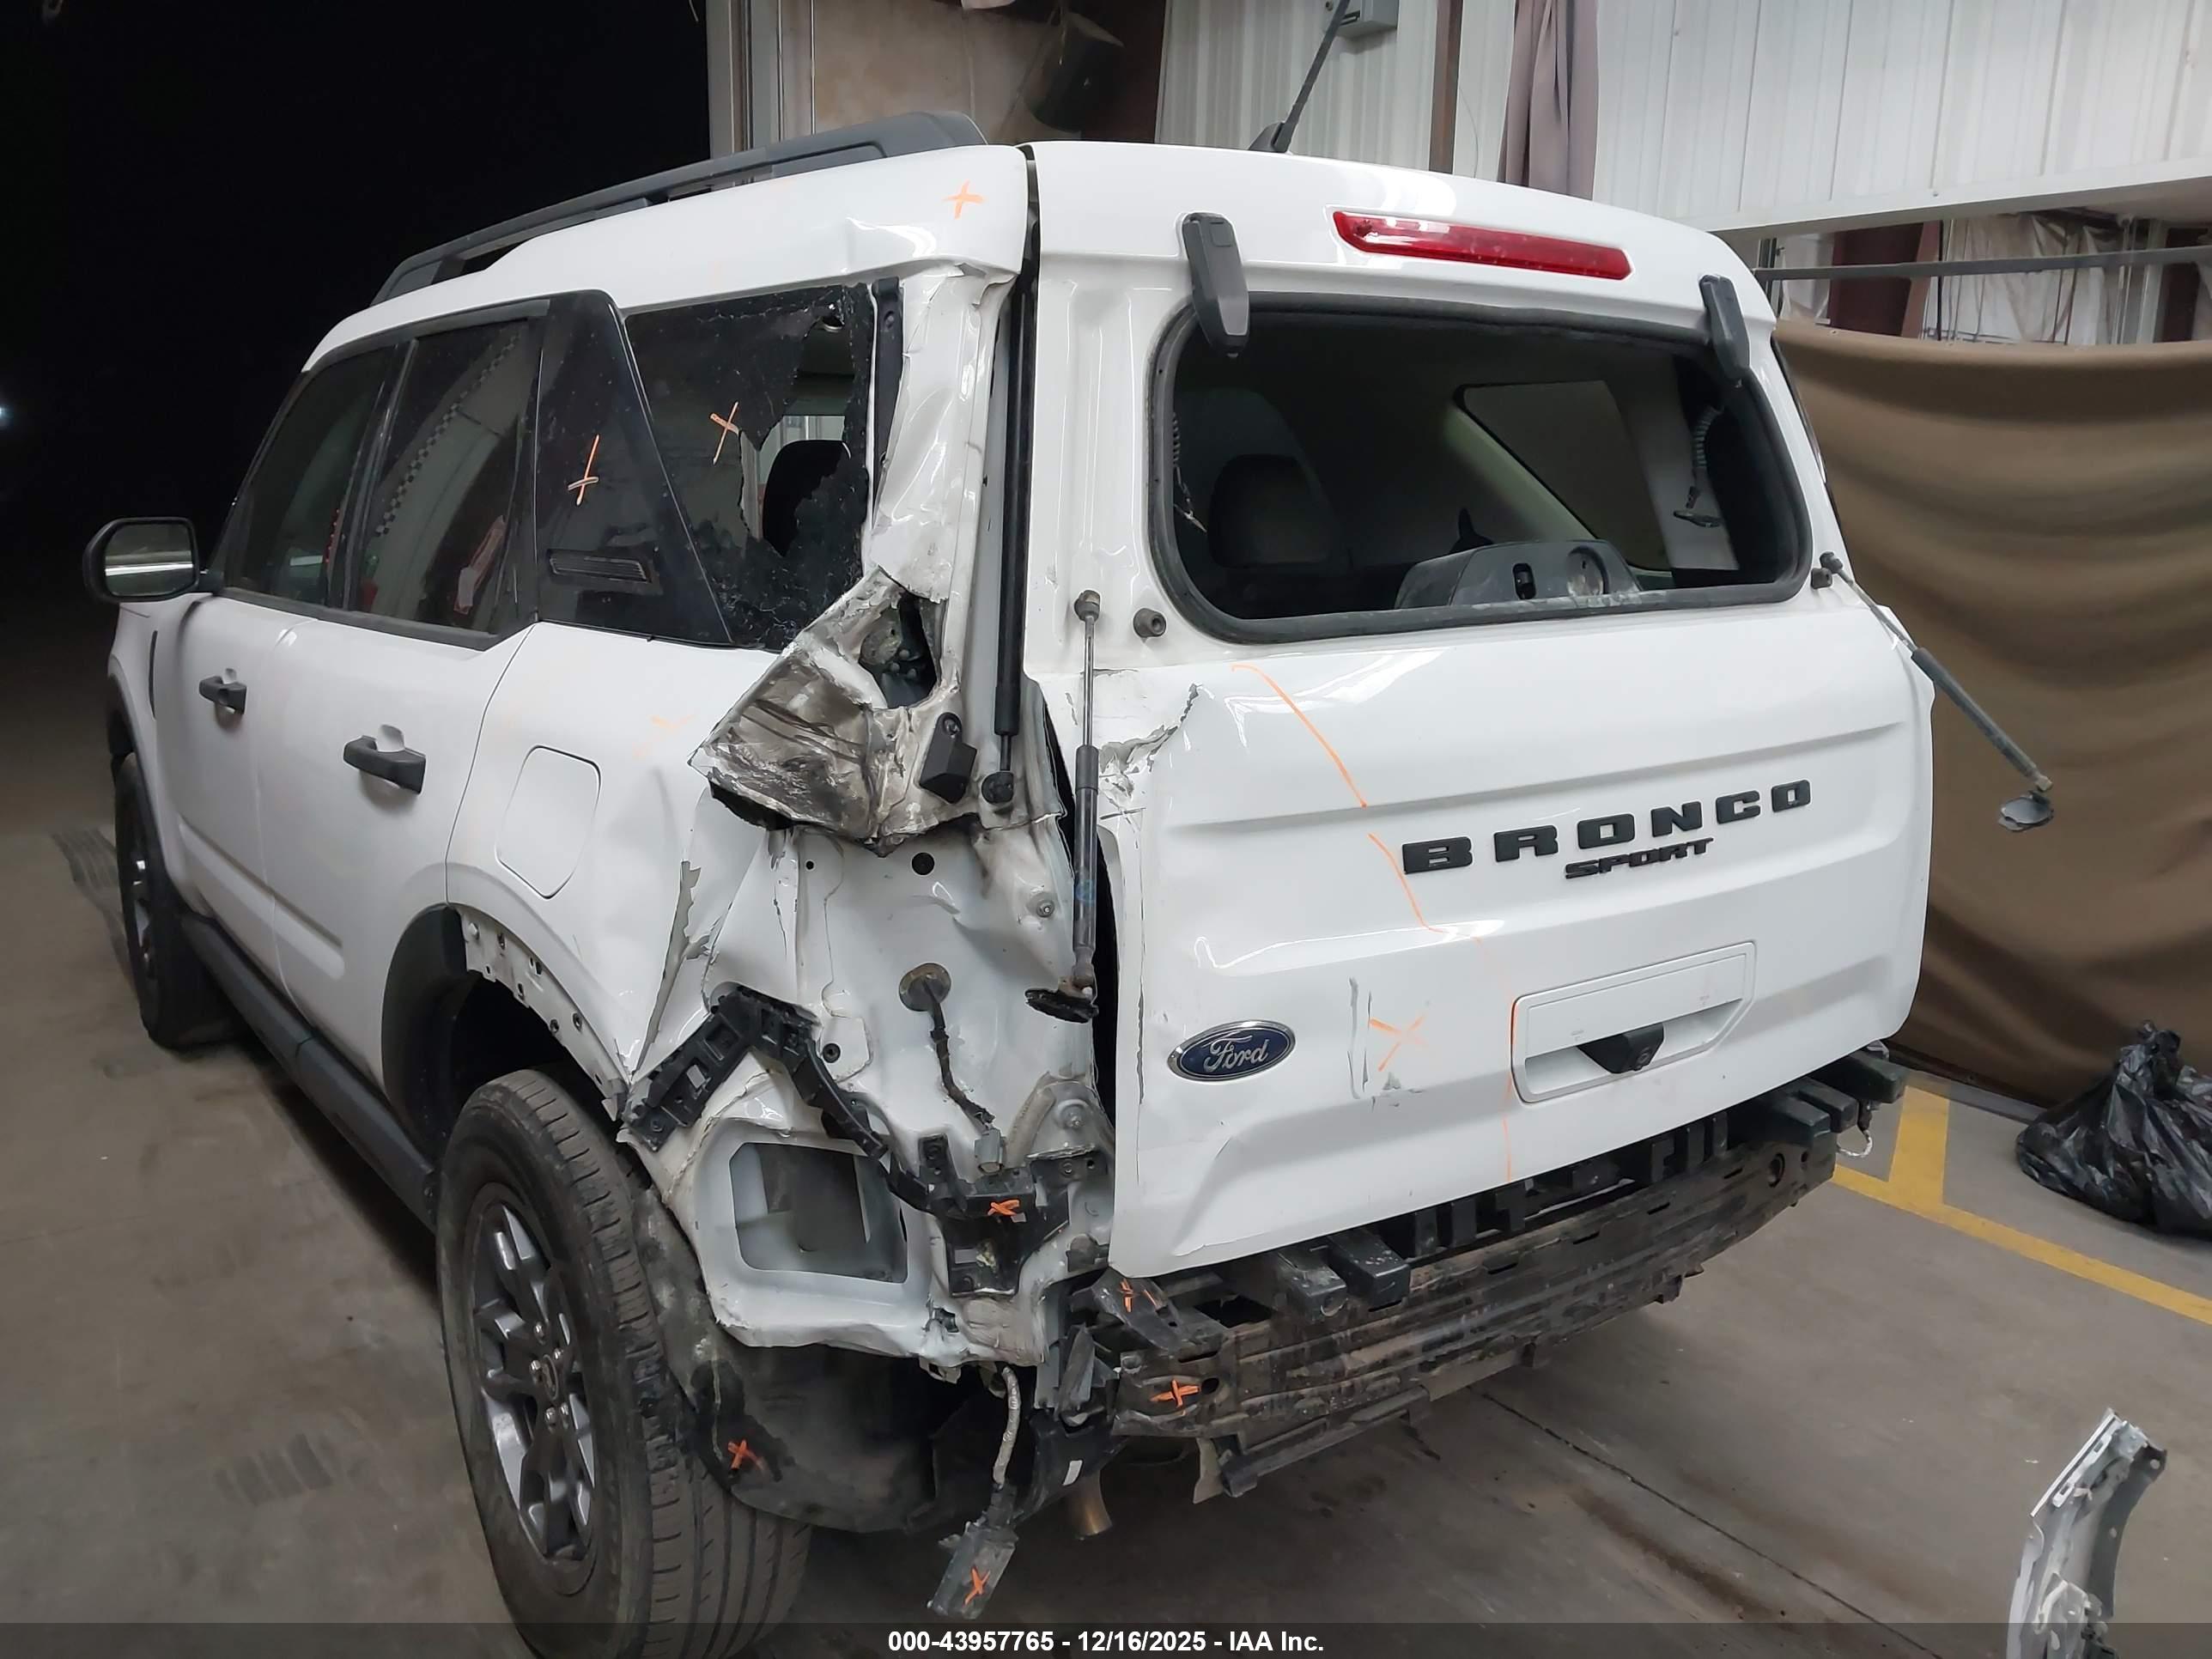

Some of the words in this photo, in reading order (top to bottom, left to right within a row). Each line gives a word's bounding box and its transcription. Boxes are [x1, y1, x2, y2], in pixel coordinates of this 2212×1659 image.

[1402, 779, 1811, 875] BRONCO
[1565, 837, 1714, 880] SPORT
[1201, 1031, 1269, 1073] Ford
